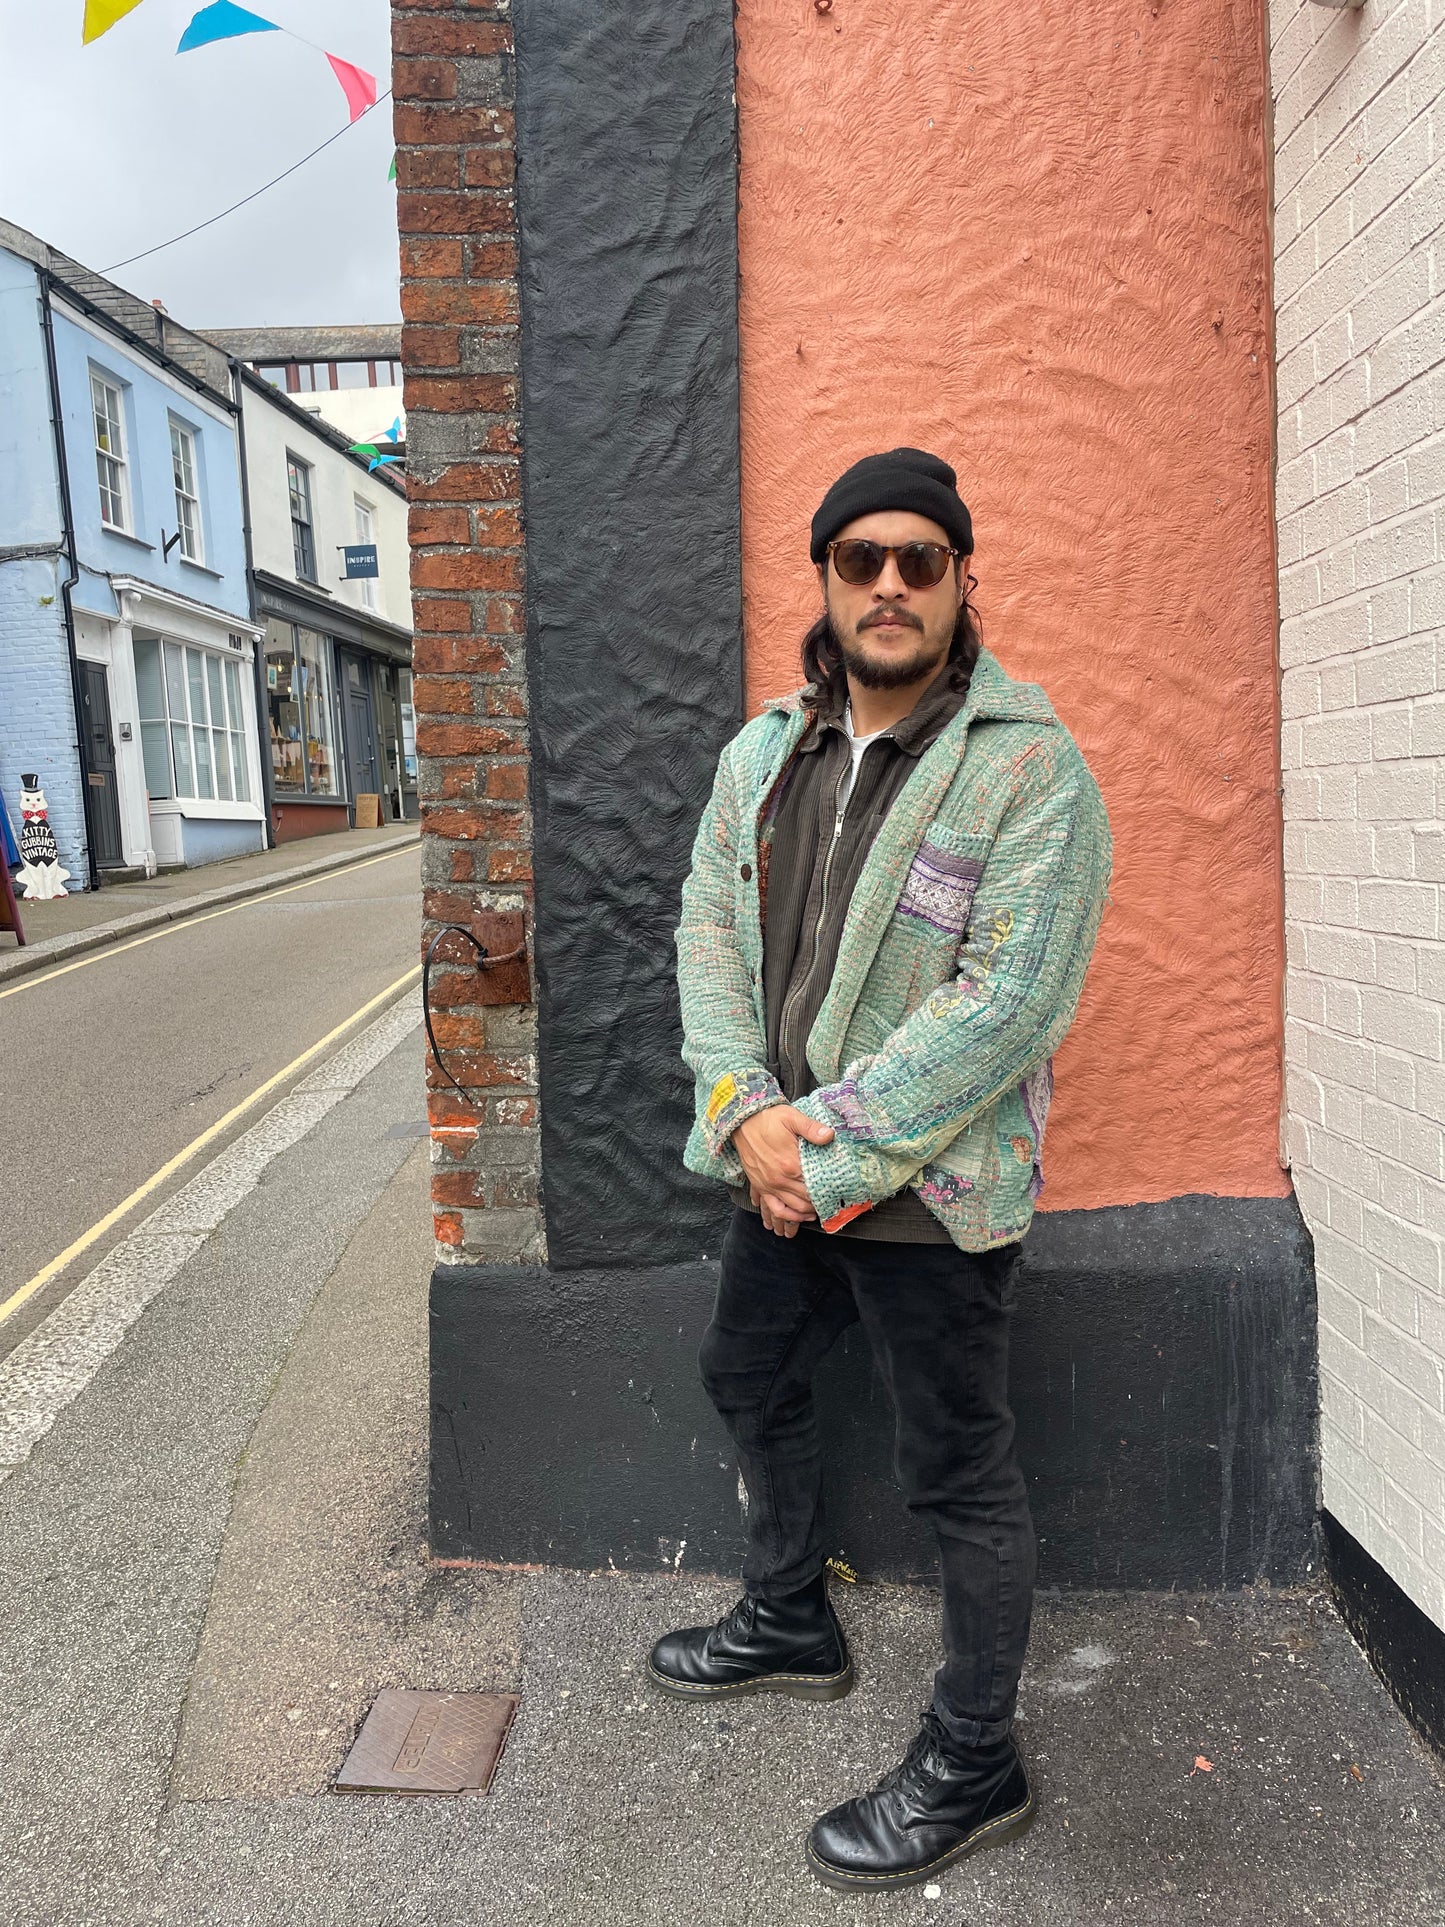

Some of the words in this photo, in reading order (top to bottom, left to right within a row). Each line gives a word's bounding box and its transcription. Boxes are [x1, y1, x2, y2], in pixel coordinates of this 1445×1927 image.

[22, 826, 51, 838] KITTY
[21, 837, 55, 850] GUBBINS
[22, 846, 58, 860] VINTAGE
